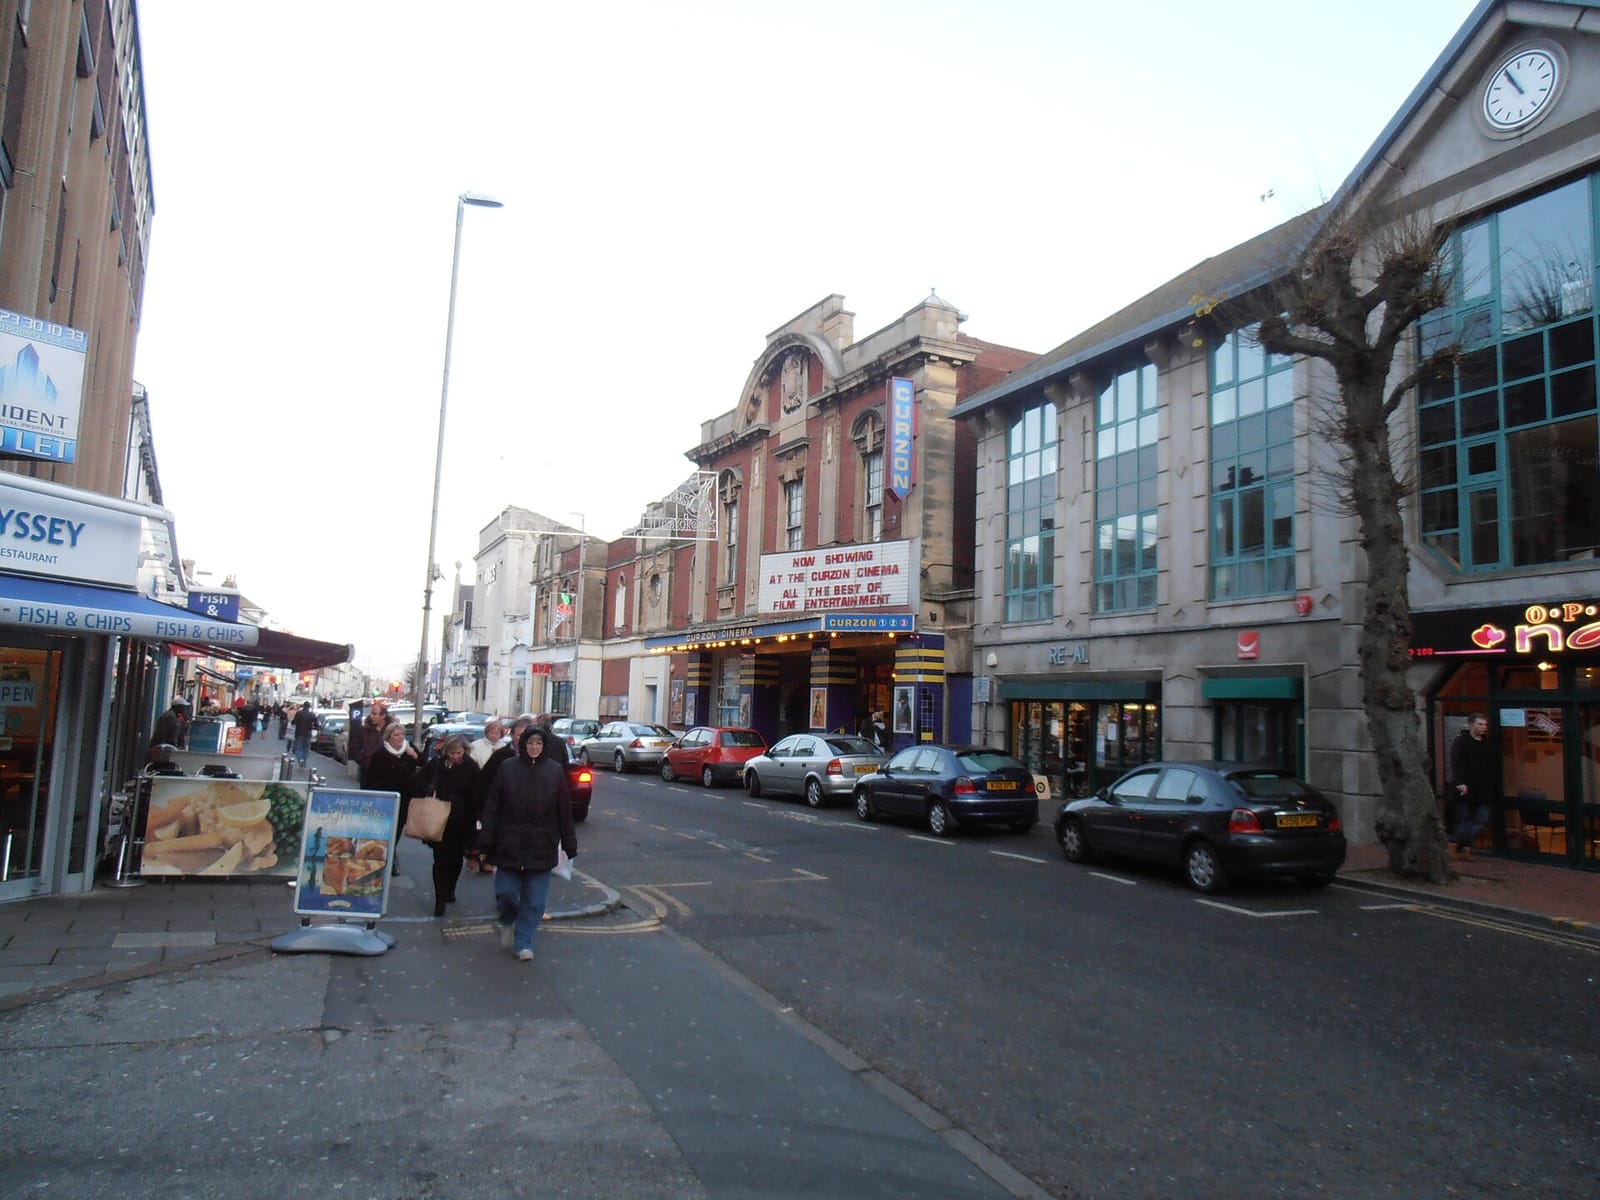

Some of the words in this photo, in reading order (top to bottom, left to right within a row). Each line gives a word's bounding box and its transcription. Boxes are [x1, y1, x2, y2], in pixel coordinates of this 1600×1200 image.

[24, 316, 44, 332] 30
[47, 324, 63, 337] 10
[66, 328, 85, 342] 33
[2, 404, 69, 429] IDENT
[15, 430, 73, 458] LET
[893, 387, 911, 489] CURZON
[0, 507, 86, 548] YSSEY
[0, 547, 59, 564] ESTAURANT
[792, 556, 816, 568] NOW
[825, 550, 873, 565] SHOWING
[769, 575, 783, 584] AT
[788, 572, 805, 583] THE
[811, 569, 850, 581] CURZON
[856, 564, 900, 577] CINEMA
[783, 588, 798, 598] ALL
[808, 586, 830, 597] THE
[833, 583, 861, 595] BEST
[867, 582, 881, 593] OF
[207, 604, 219, 616] &
[773, 600, 796, 610] FILM
[804, 594, 891, 610] ENTERTAINMENT
[18, 606, 58, 625] FISH
[65, 611, 78, 627] &
[84, 613, 132, 632] CHIPS
[829, 619, 877, 627] CURZON
[156, 621, 187, 638] FISH
[192, 625, 202, 639] &
[207, 626, 244, 643] CHIPS
[686, 631, 717, 642] CURZON
[722, 627, 753, 638] CINEMA
[1, 686, 34, 702] PEN
[353, 710, 361, 719] P
